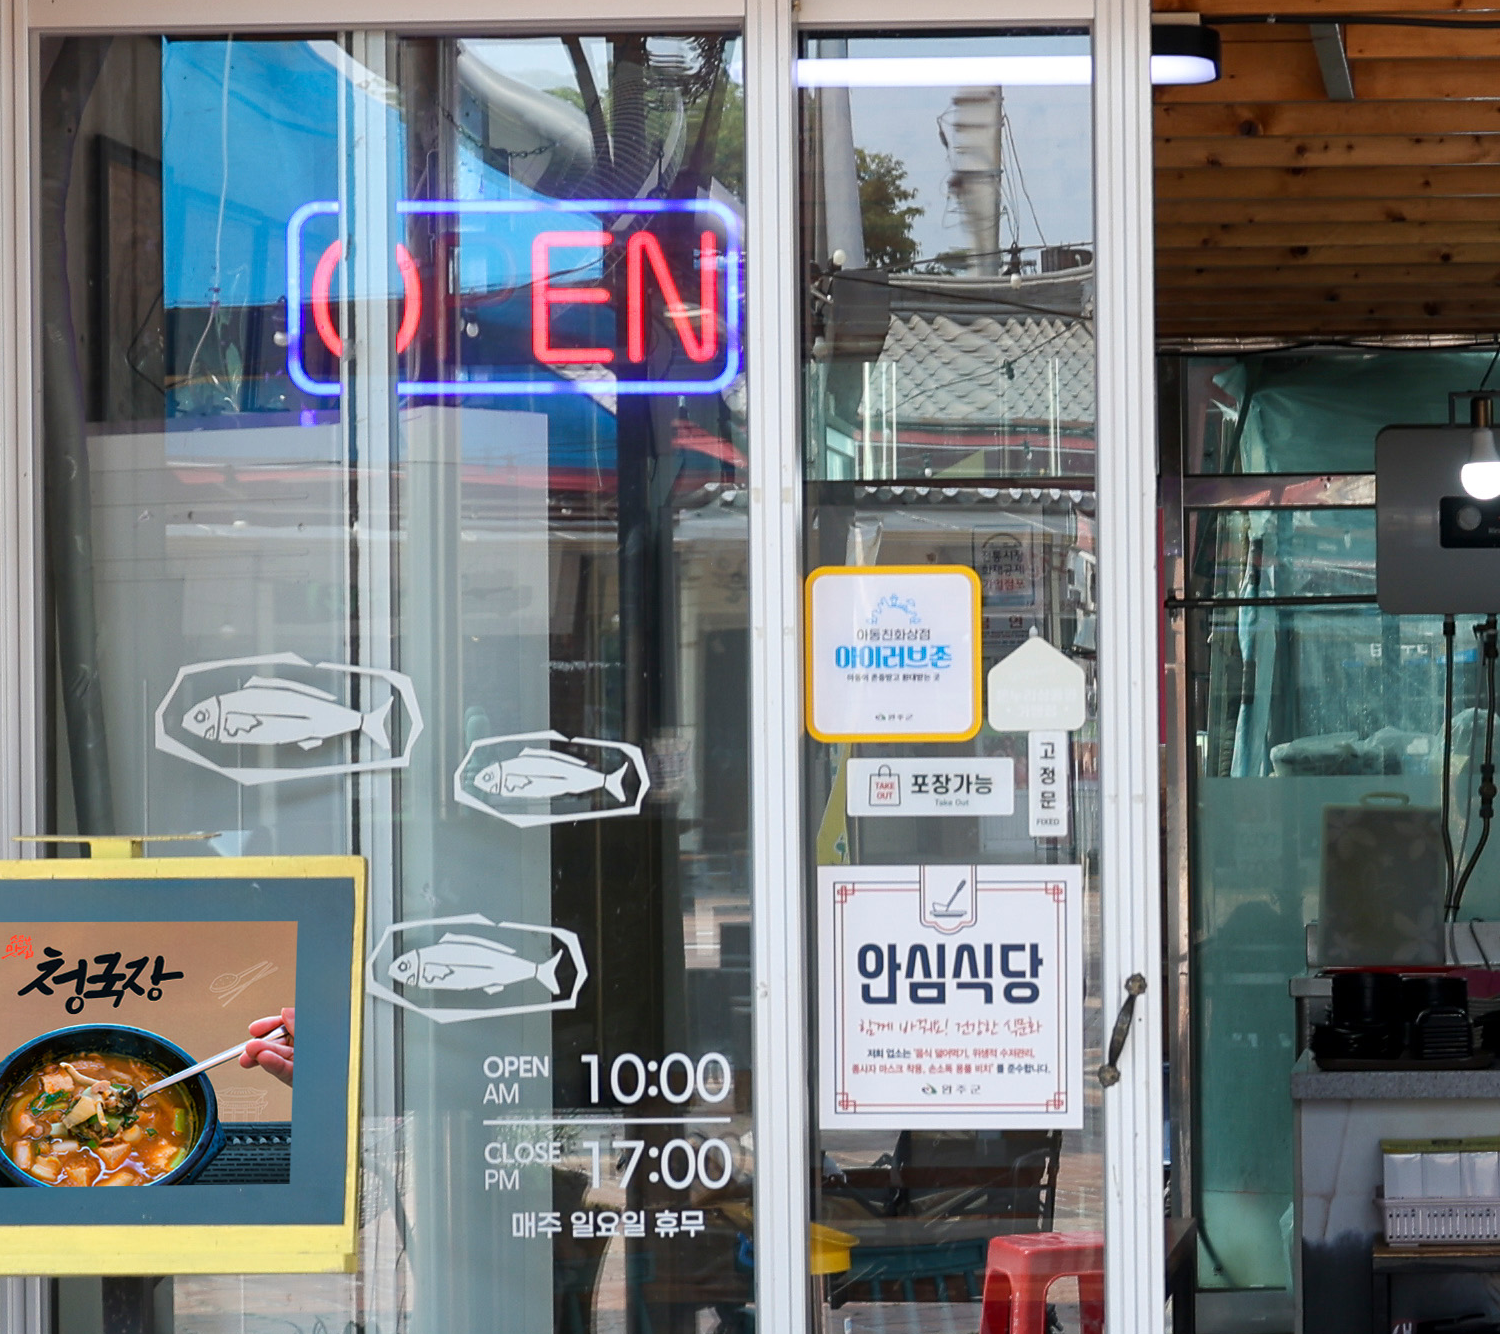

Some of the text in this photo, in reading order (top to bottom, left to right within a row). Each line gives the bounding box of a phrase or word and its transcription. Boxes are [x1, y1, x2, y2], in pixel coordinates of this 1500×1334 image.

[857, 628, 931, 641] 아동친화상점
[835, 645, 952, 669] 아이러브존
[875, 782, 895, 791] TAKE
[911, 774, 993, 795] 포장가능
[1040, 742, 1056, 808] 고정문
[877, 792, 893, 800] OUT
[1, 943, 34, 960] 맛집
[17, 946, 185, 1015] 청국장
[857, 942, 1044, 1005] 안심식당
[482, 1056, 550, 1079] OPEN
[579, 1051, 732, 1106] 10:00
[482, 1082, 520, 1105] AM
[483, 1142, 562, 1166] CLOSE
[584, 1138, 732, 1191] 17:00
[484, 1169, 520, 1192] PM
[511, 1210, 705, 1239] 매주 일요일 휴무
